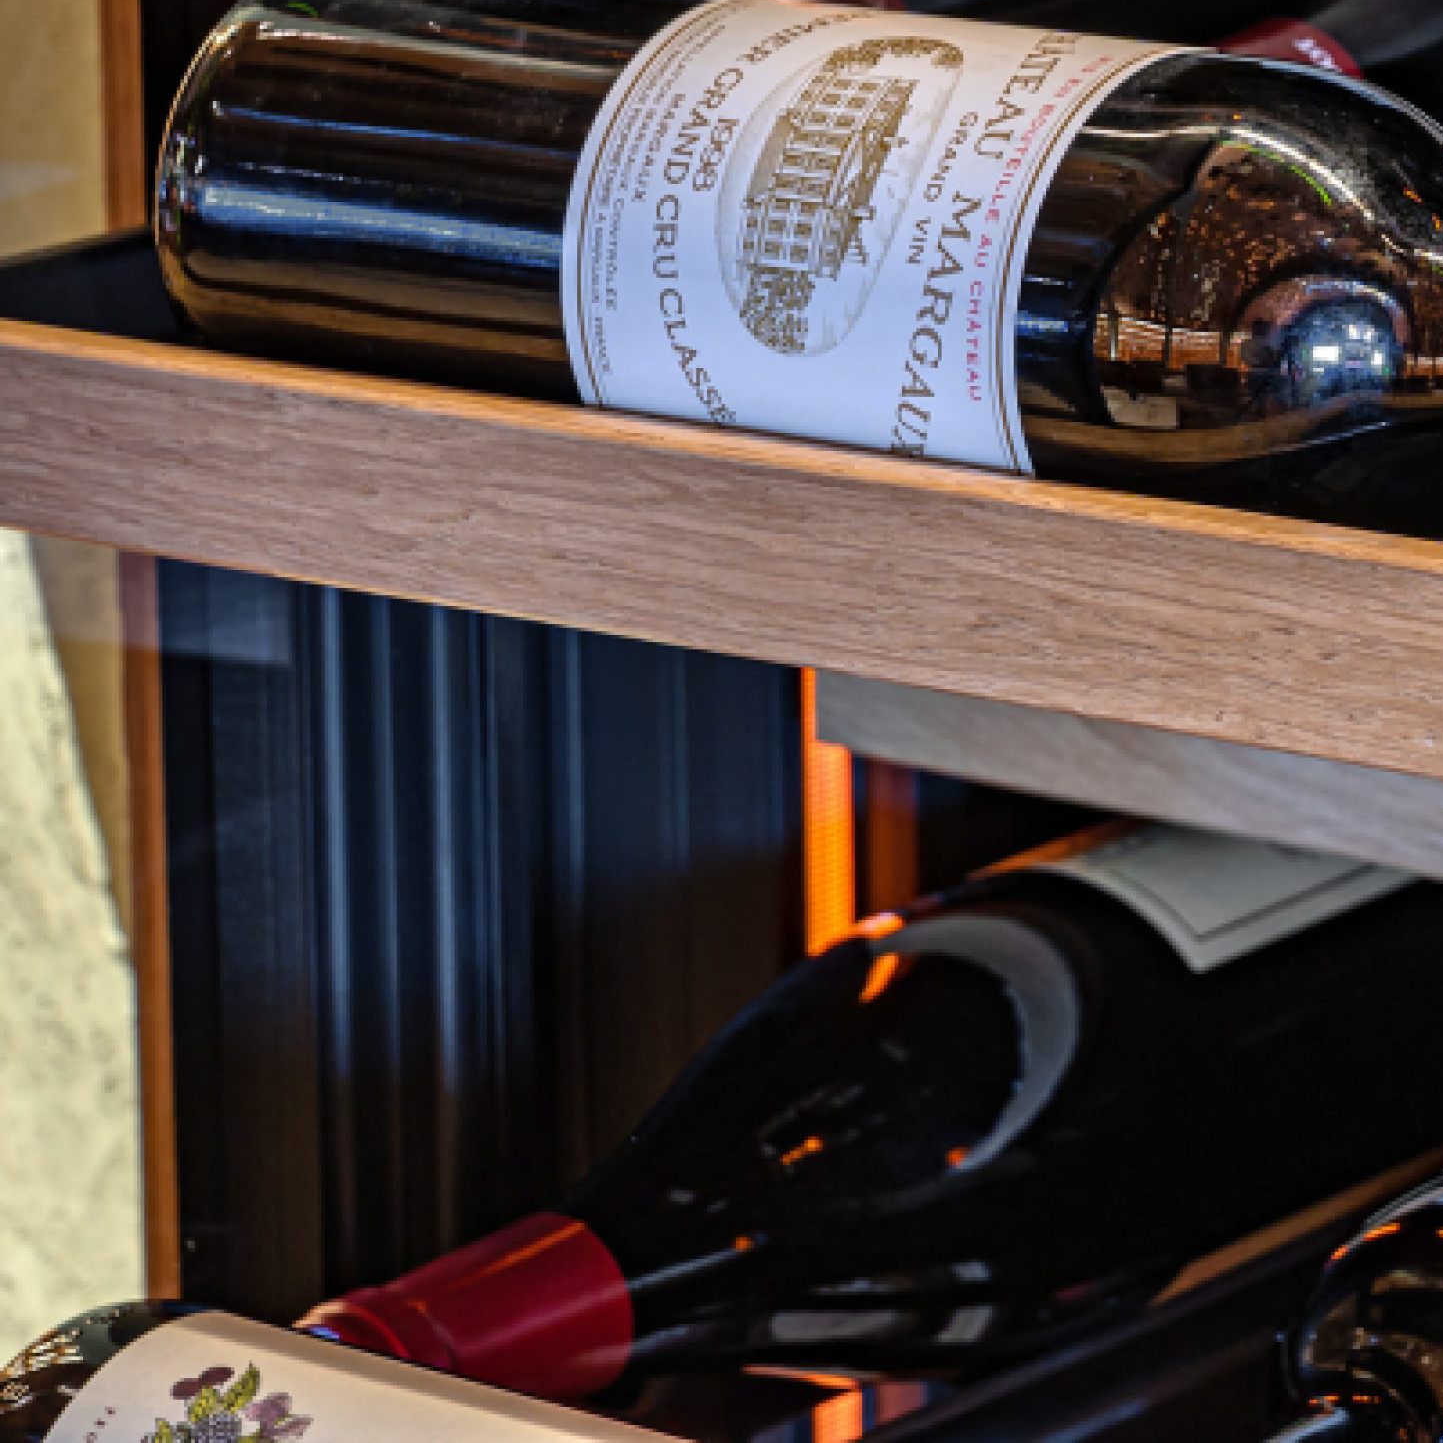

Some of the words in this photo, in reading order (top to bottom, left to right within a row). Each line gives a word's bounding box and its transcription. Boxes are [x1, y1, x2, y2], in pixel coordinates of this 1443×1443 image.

[662, 66, 745, 186] GRAND
[691, 117, 741, 192] 1998
[923, 110, 979, 203] GRAND
[984, 103, 1058, 224] BOUTEILLE
[652, 193, 682, 280] CRU
[905, 216, 932, 265] VIN
[974, 232, 994, 268] AU
